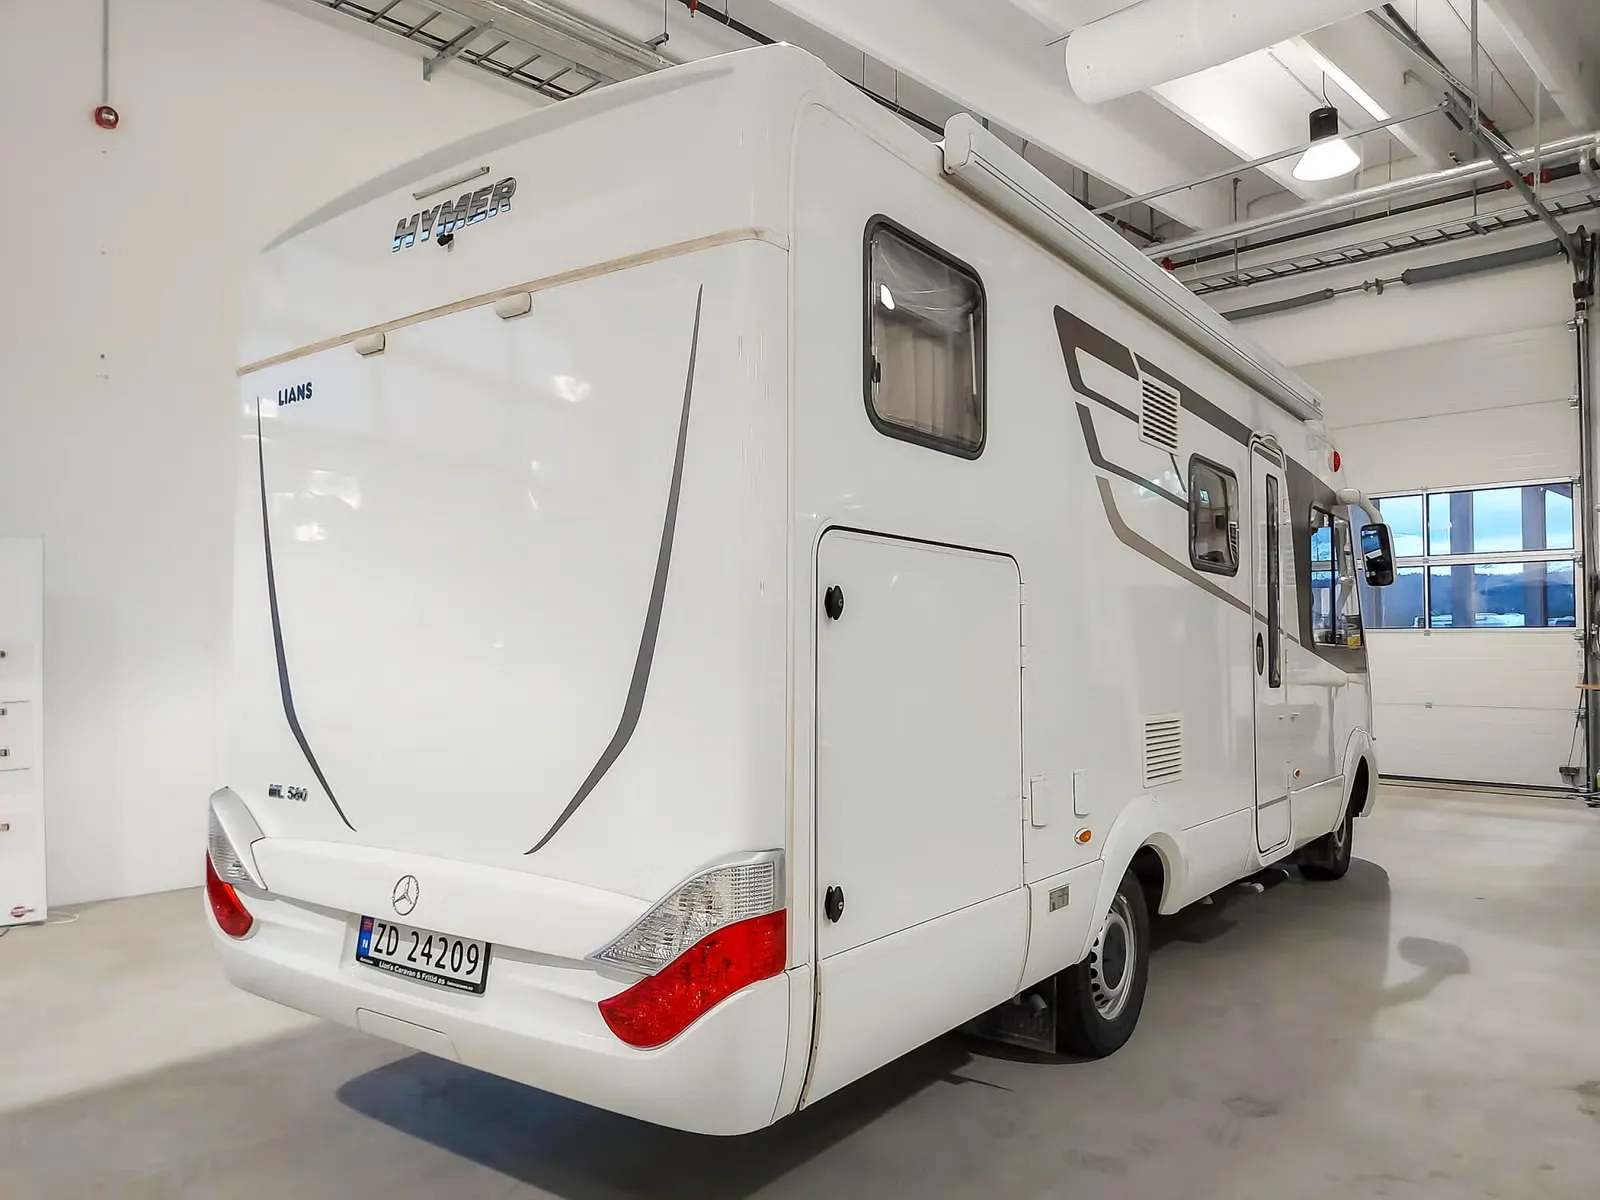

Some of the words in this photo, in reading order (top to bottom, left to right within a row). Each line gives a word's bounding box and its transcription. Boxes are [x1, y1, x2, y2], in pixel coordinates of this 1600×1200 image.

[391, 176, 517, 253] HYMER
[278, 381, 313, 407] LIANS
[362, 939, 369, 949] N
[373, 923, 399, 956] ZD
[407, 931, 479, 976] 24209
